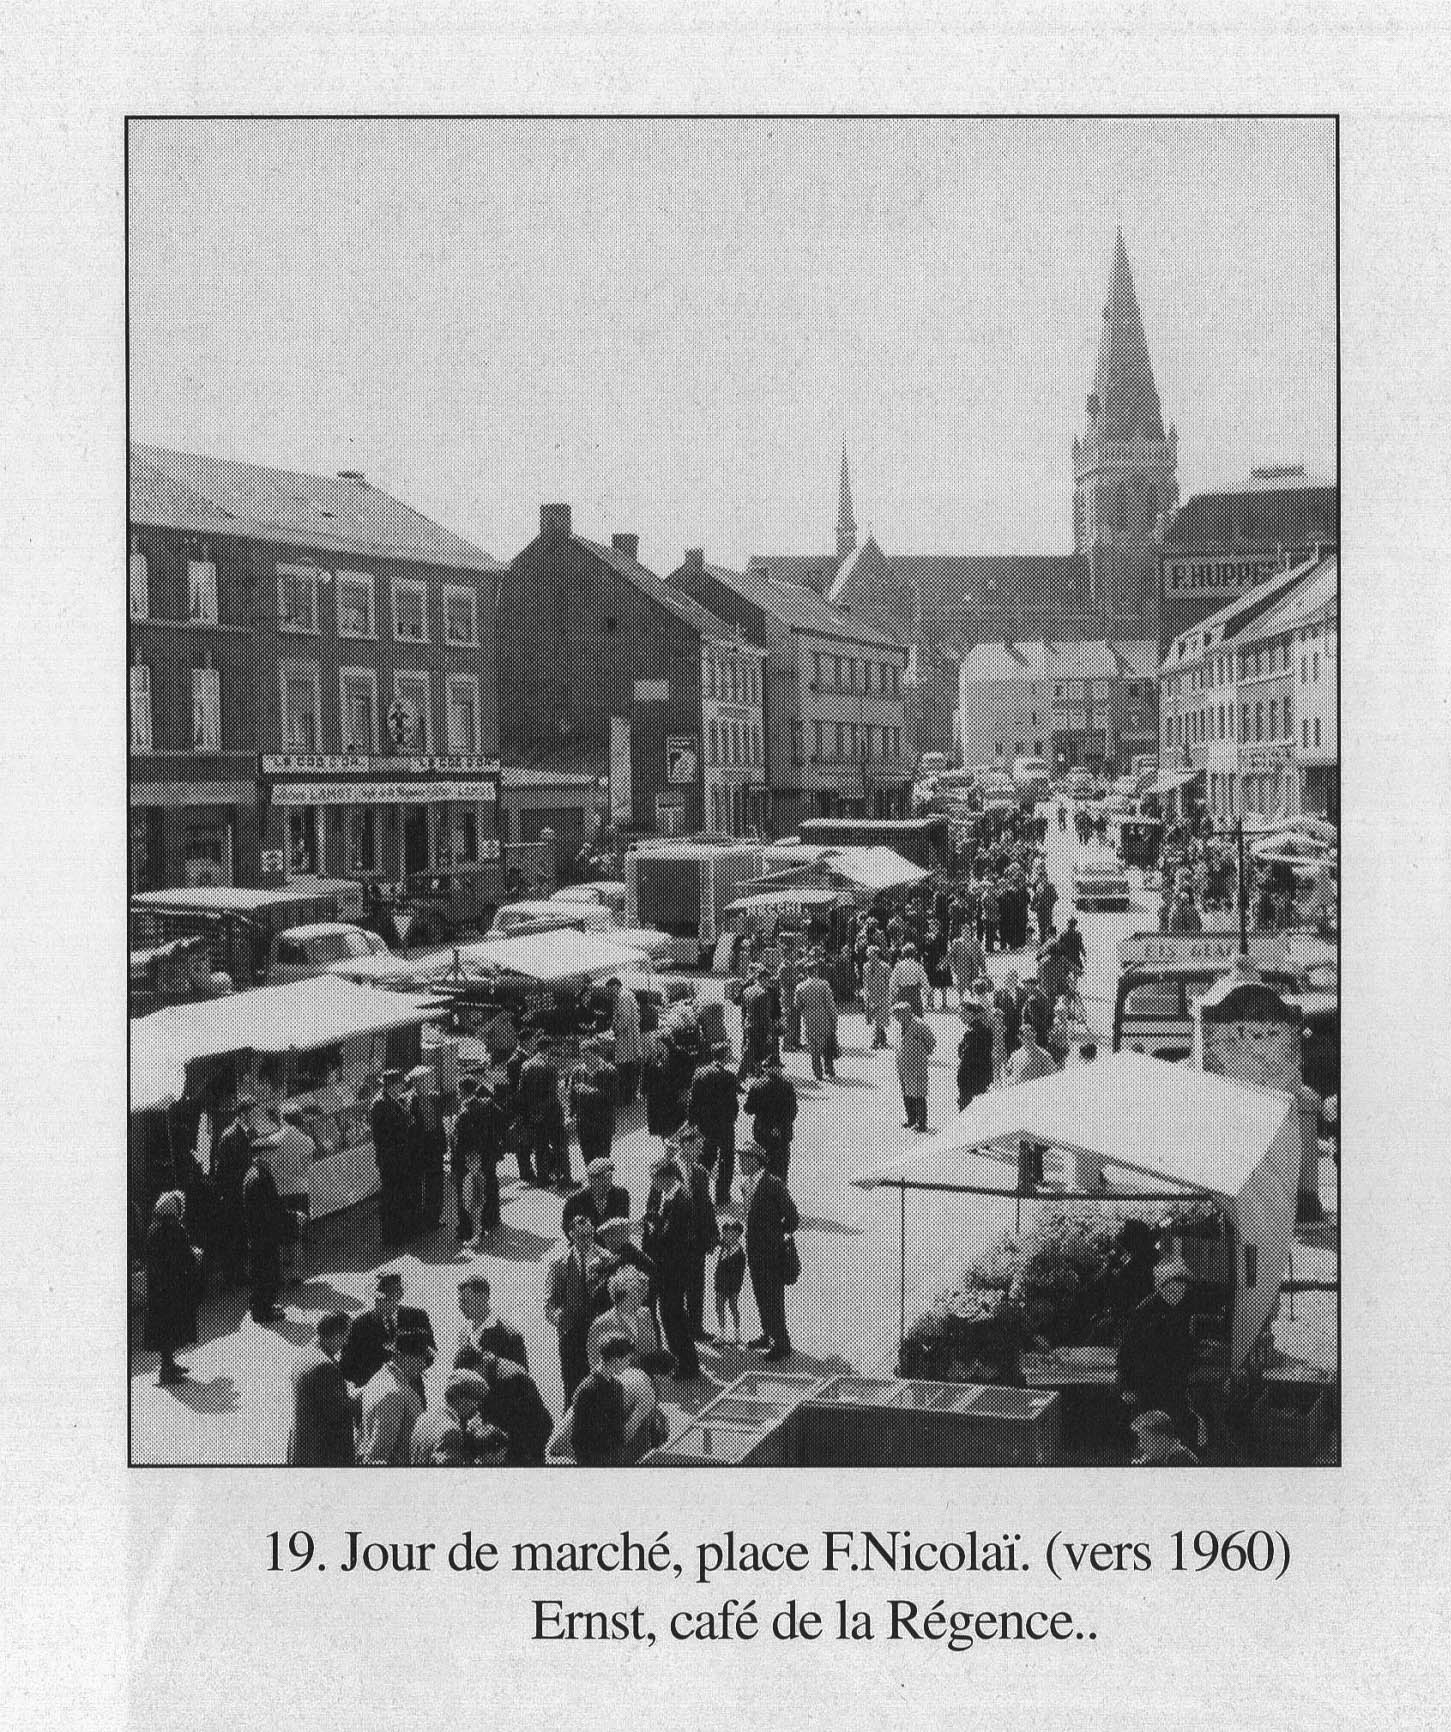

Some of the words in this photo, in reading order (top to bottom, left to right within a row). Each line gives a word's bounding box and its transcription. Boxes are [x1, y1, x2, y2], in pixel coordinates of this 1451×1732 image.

[1144, 943, 1177, 958] EIS
[267, 1531, 327, 1571] 19.
[341, 1531, 436, 1571] Jour
[448, 1531, 498, 1571] de
[512, 1531, 683, 1578] marché,
[697, 1531, 809, 1583] place
[822, 1531, 1031, 1571] F.Nicolaï.
[1046, 1532, 1153, 1579] (vers
[1171, 1531, 1291, 1579] 1960)
[532, 1600, 657, 1647] Ernst,
[670, 1600, 758, 1640] café
[772, 1599, 823, 1640] de
[836, 1599, 875, 1640] la
[887, 1599, 1098, 1652] Régence..
